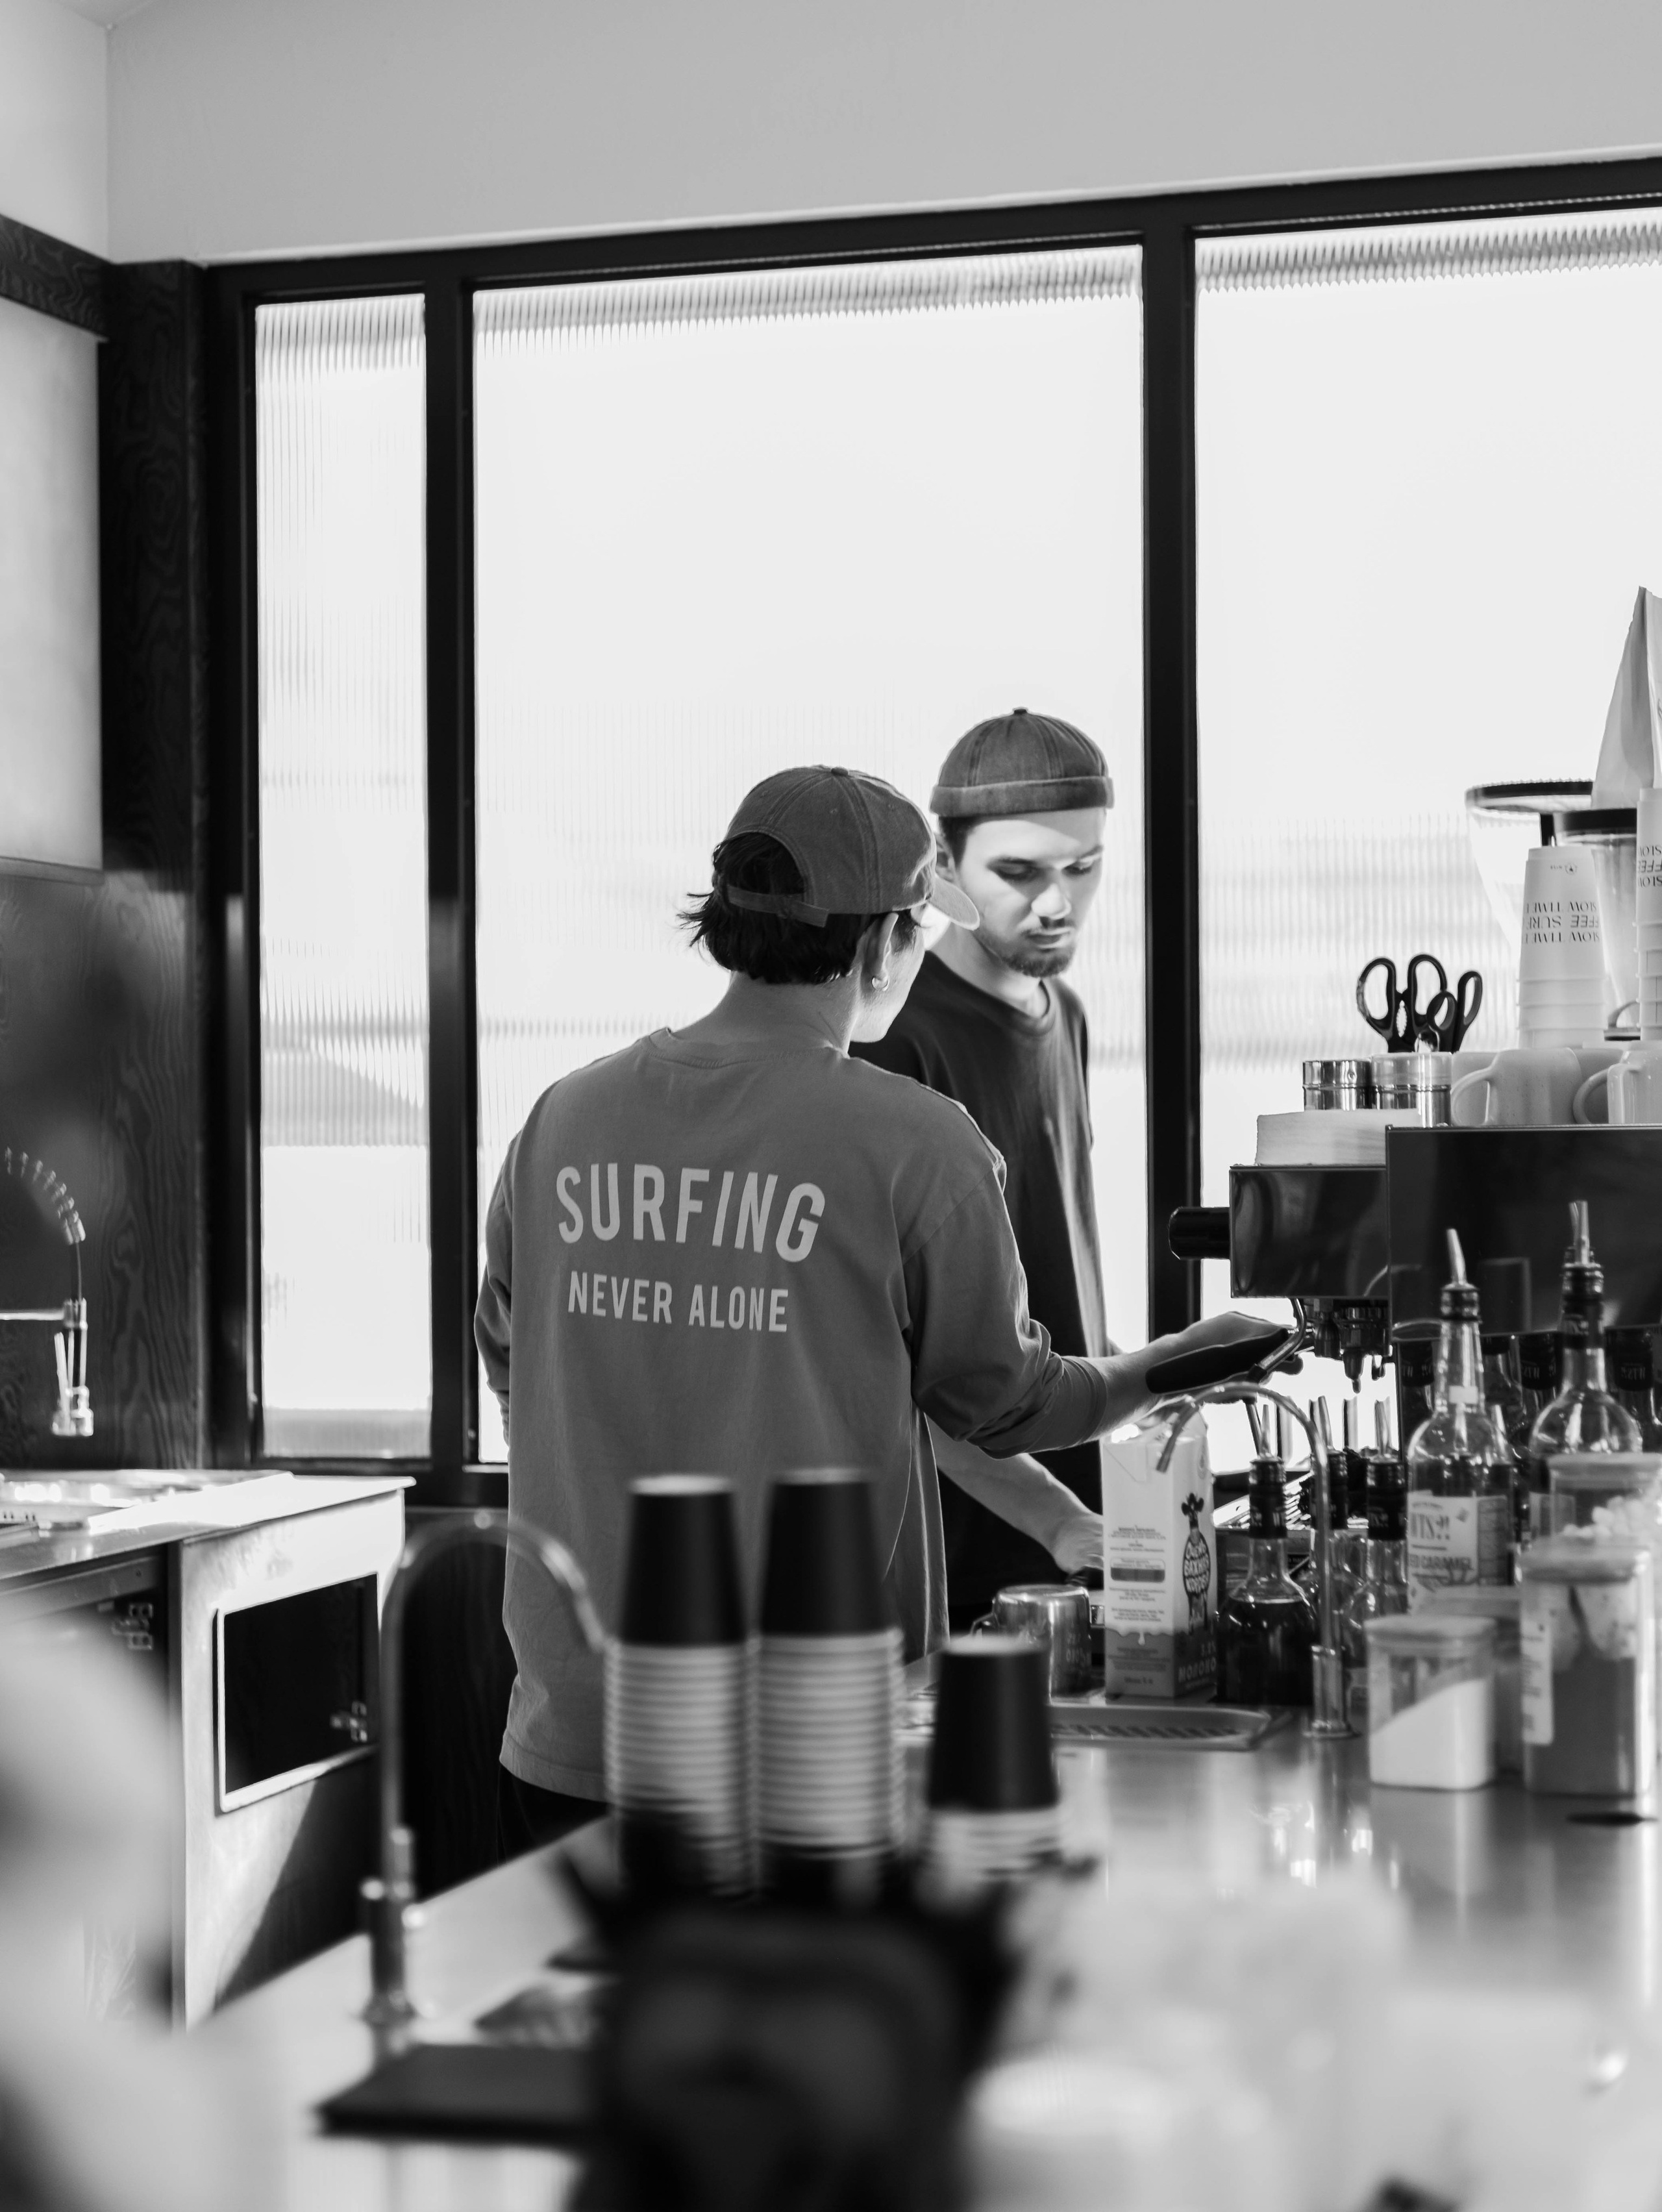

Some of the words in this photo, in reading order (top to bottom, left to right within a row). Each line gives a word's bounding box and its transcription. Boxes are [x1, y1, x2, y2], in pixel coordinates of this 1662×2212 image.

[556, 1162, 825, 1263] SURFING
[568, 1271, 673, 1324] NEVER
[688, 1284, 789, 1332] ALONE
